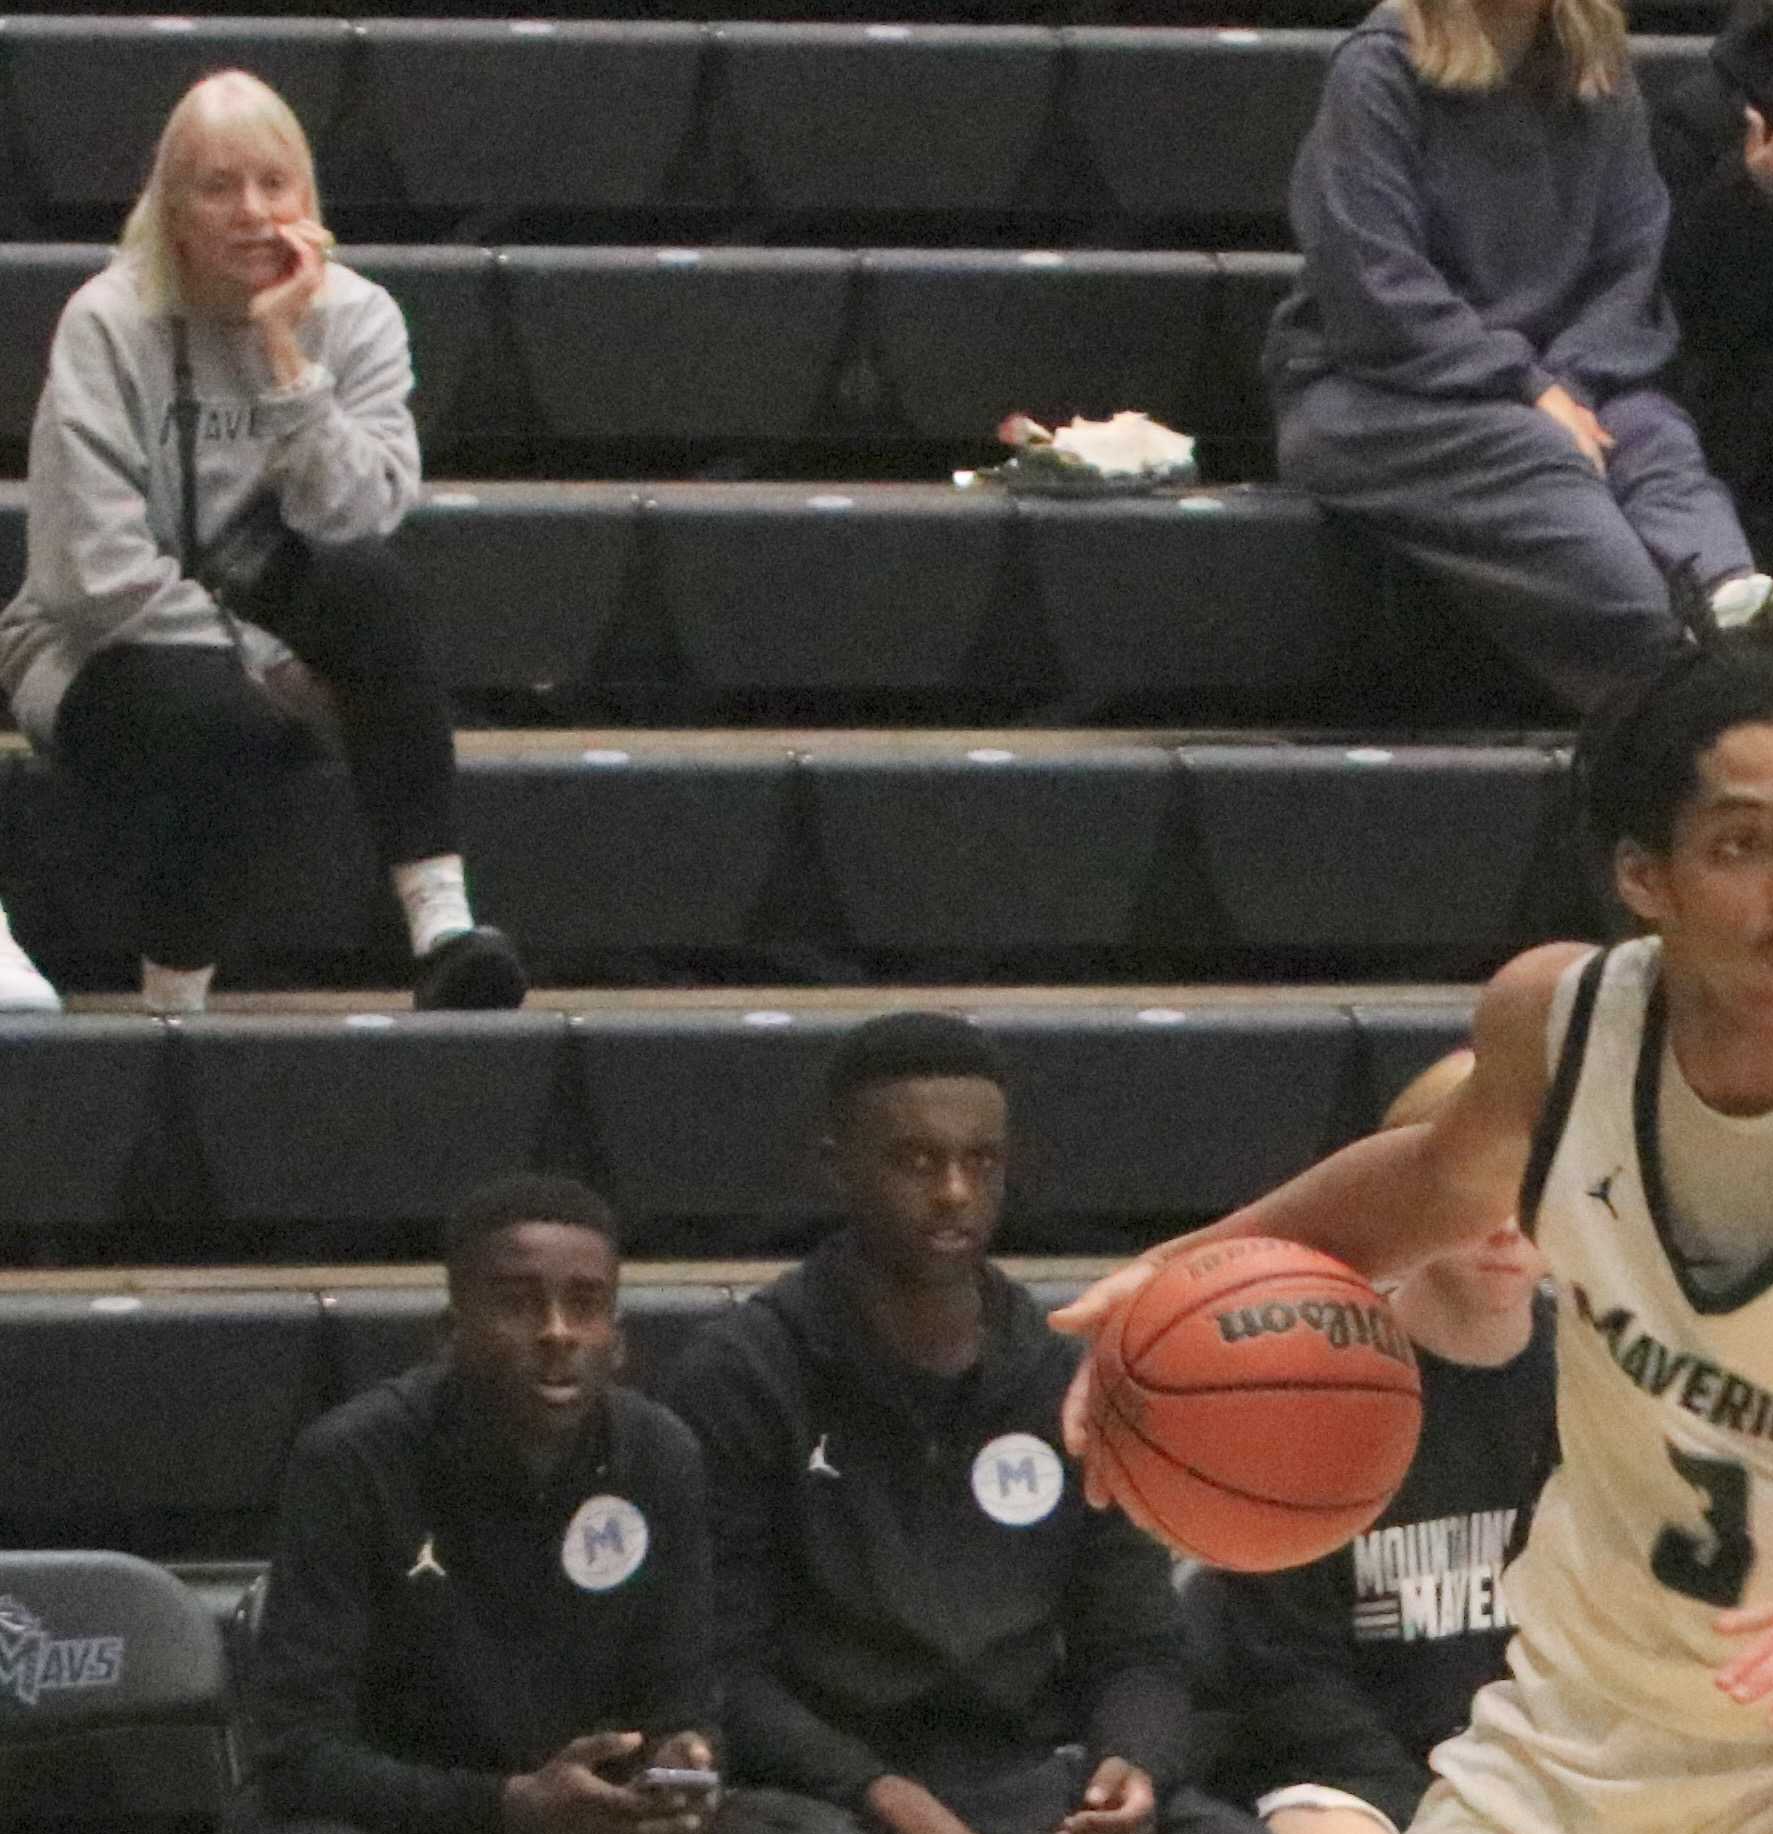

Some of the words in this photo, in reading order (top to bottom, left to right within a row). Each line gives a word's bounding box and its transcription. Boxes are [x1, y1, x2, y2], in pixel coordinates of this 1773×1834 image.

[997, 1455, 1039, 1497] M
[582, 1517, 625, 1566] M
[1653, 1434, 1757, 1609] 3
